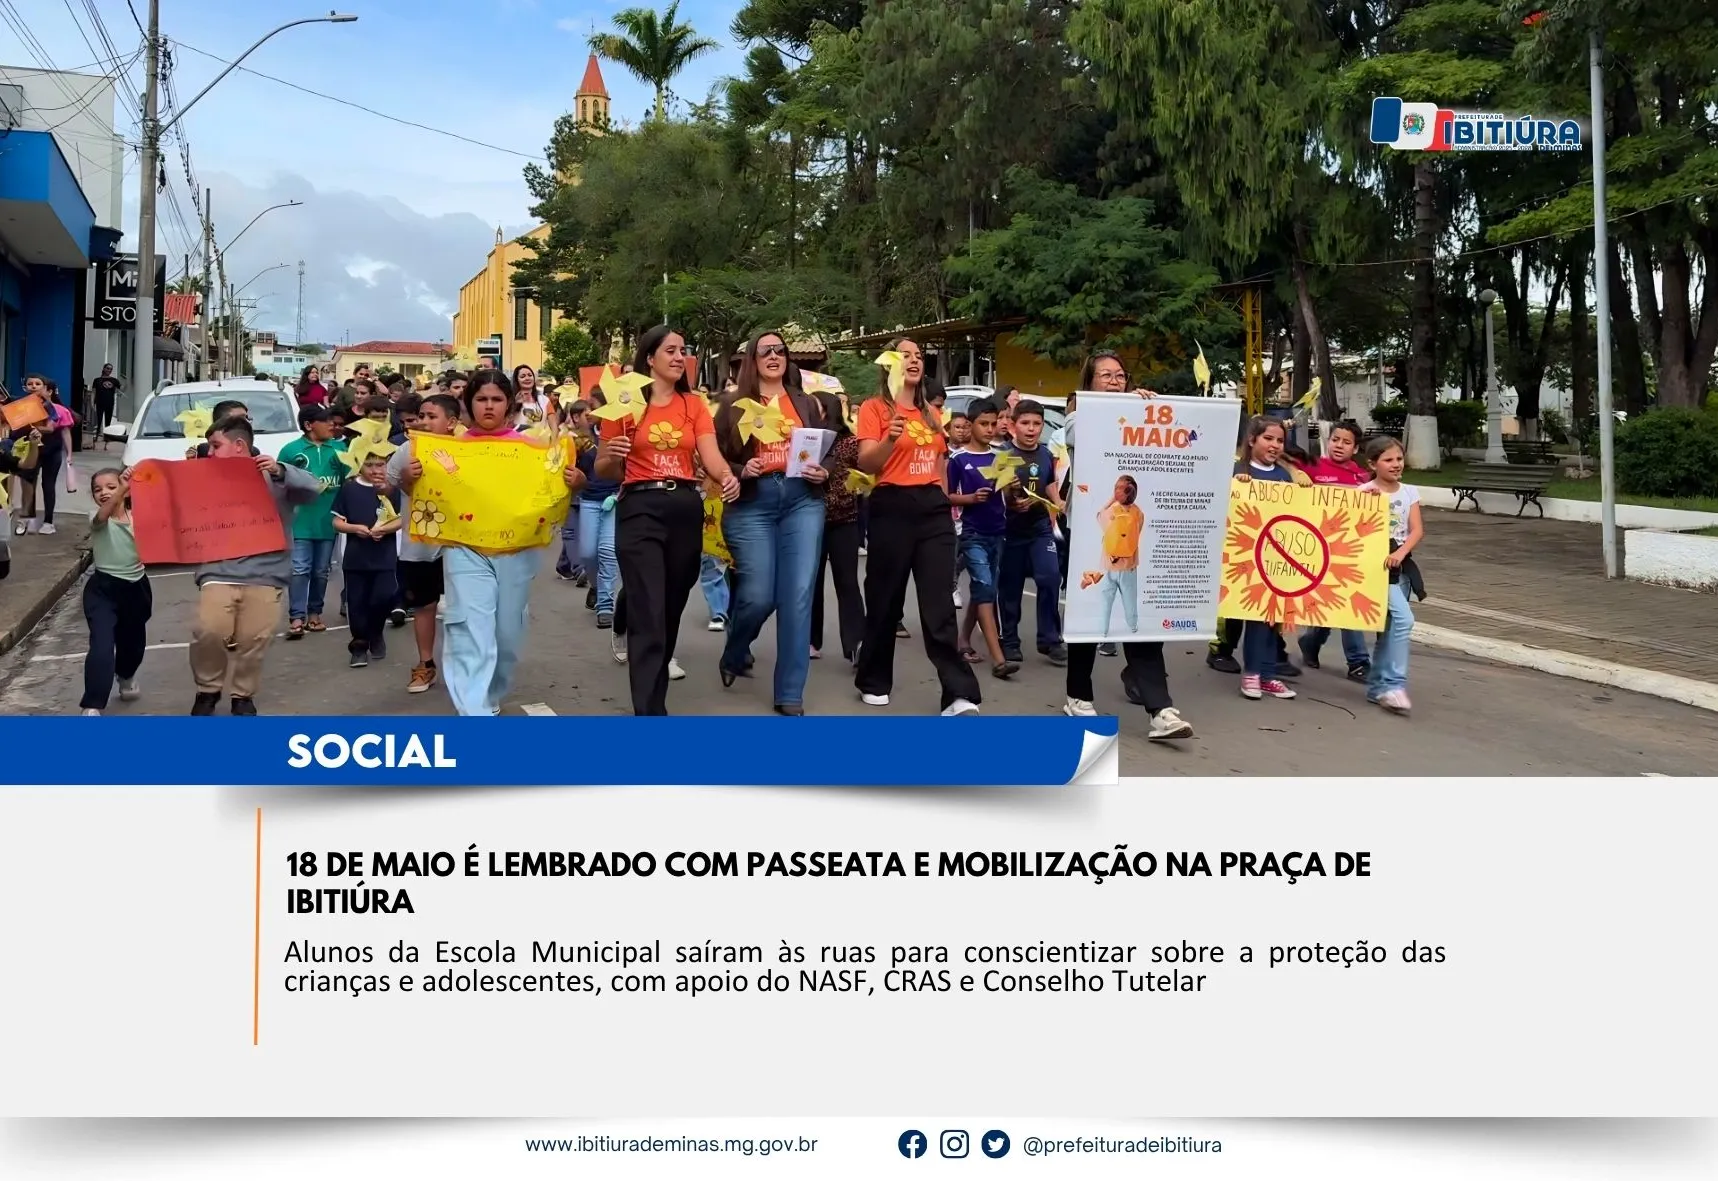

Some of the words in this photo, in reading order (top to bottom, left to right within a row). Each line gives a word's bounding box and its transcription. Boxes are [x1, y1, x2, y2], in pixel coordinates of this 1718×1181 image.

[100, 306, 158, 323] STOE
[1144, 405, 1173, 425] 18
[1123, 427, 1190, 448] MAIO
[1249, 482, 1293, 504] ABUSO
[1312, 486, 1384, 513] INFANTIL
